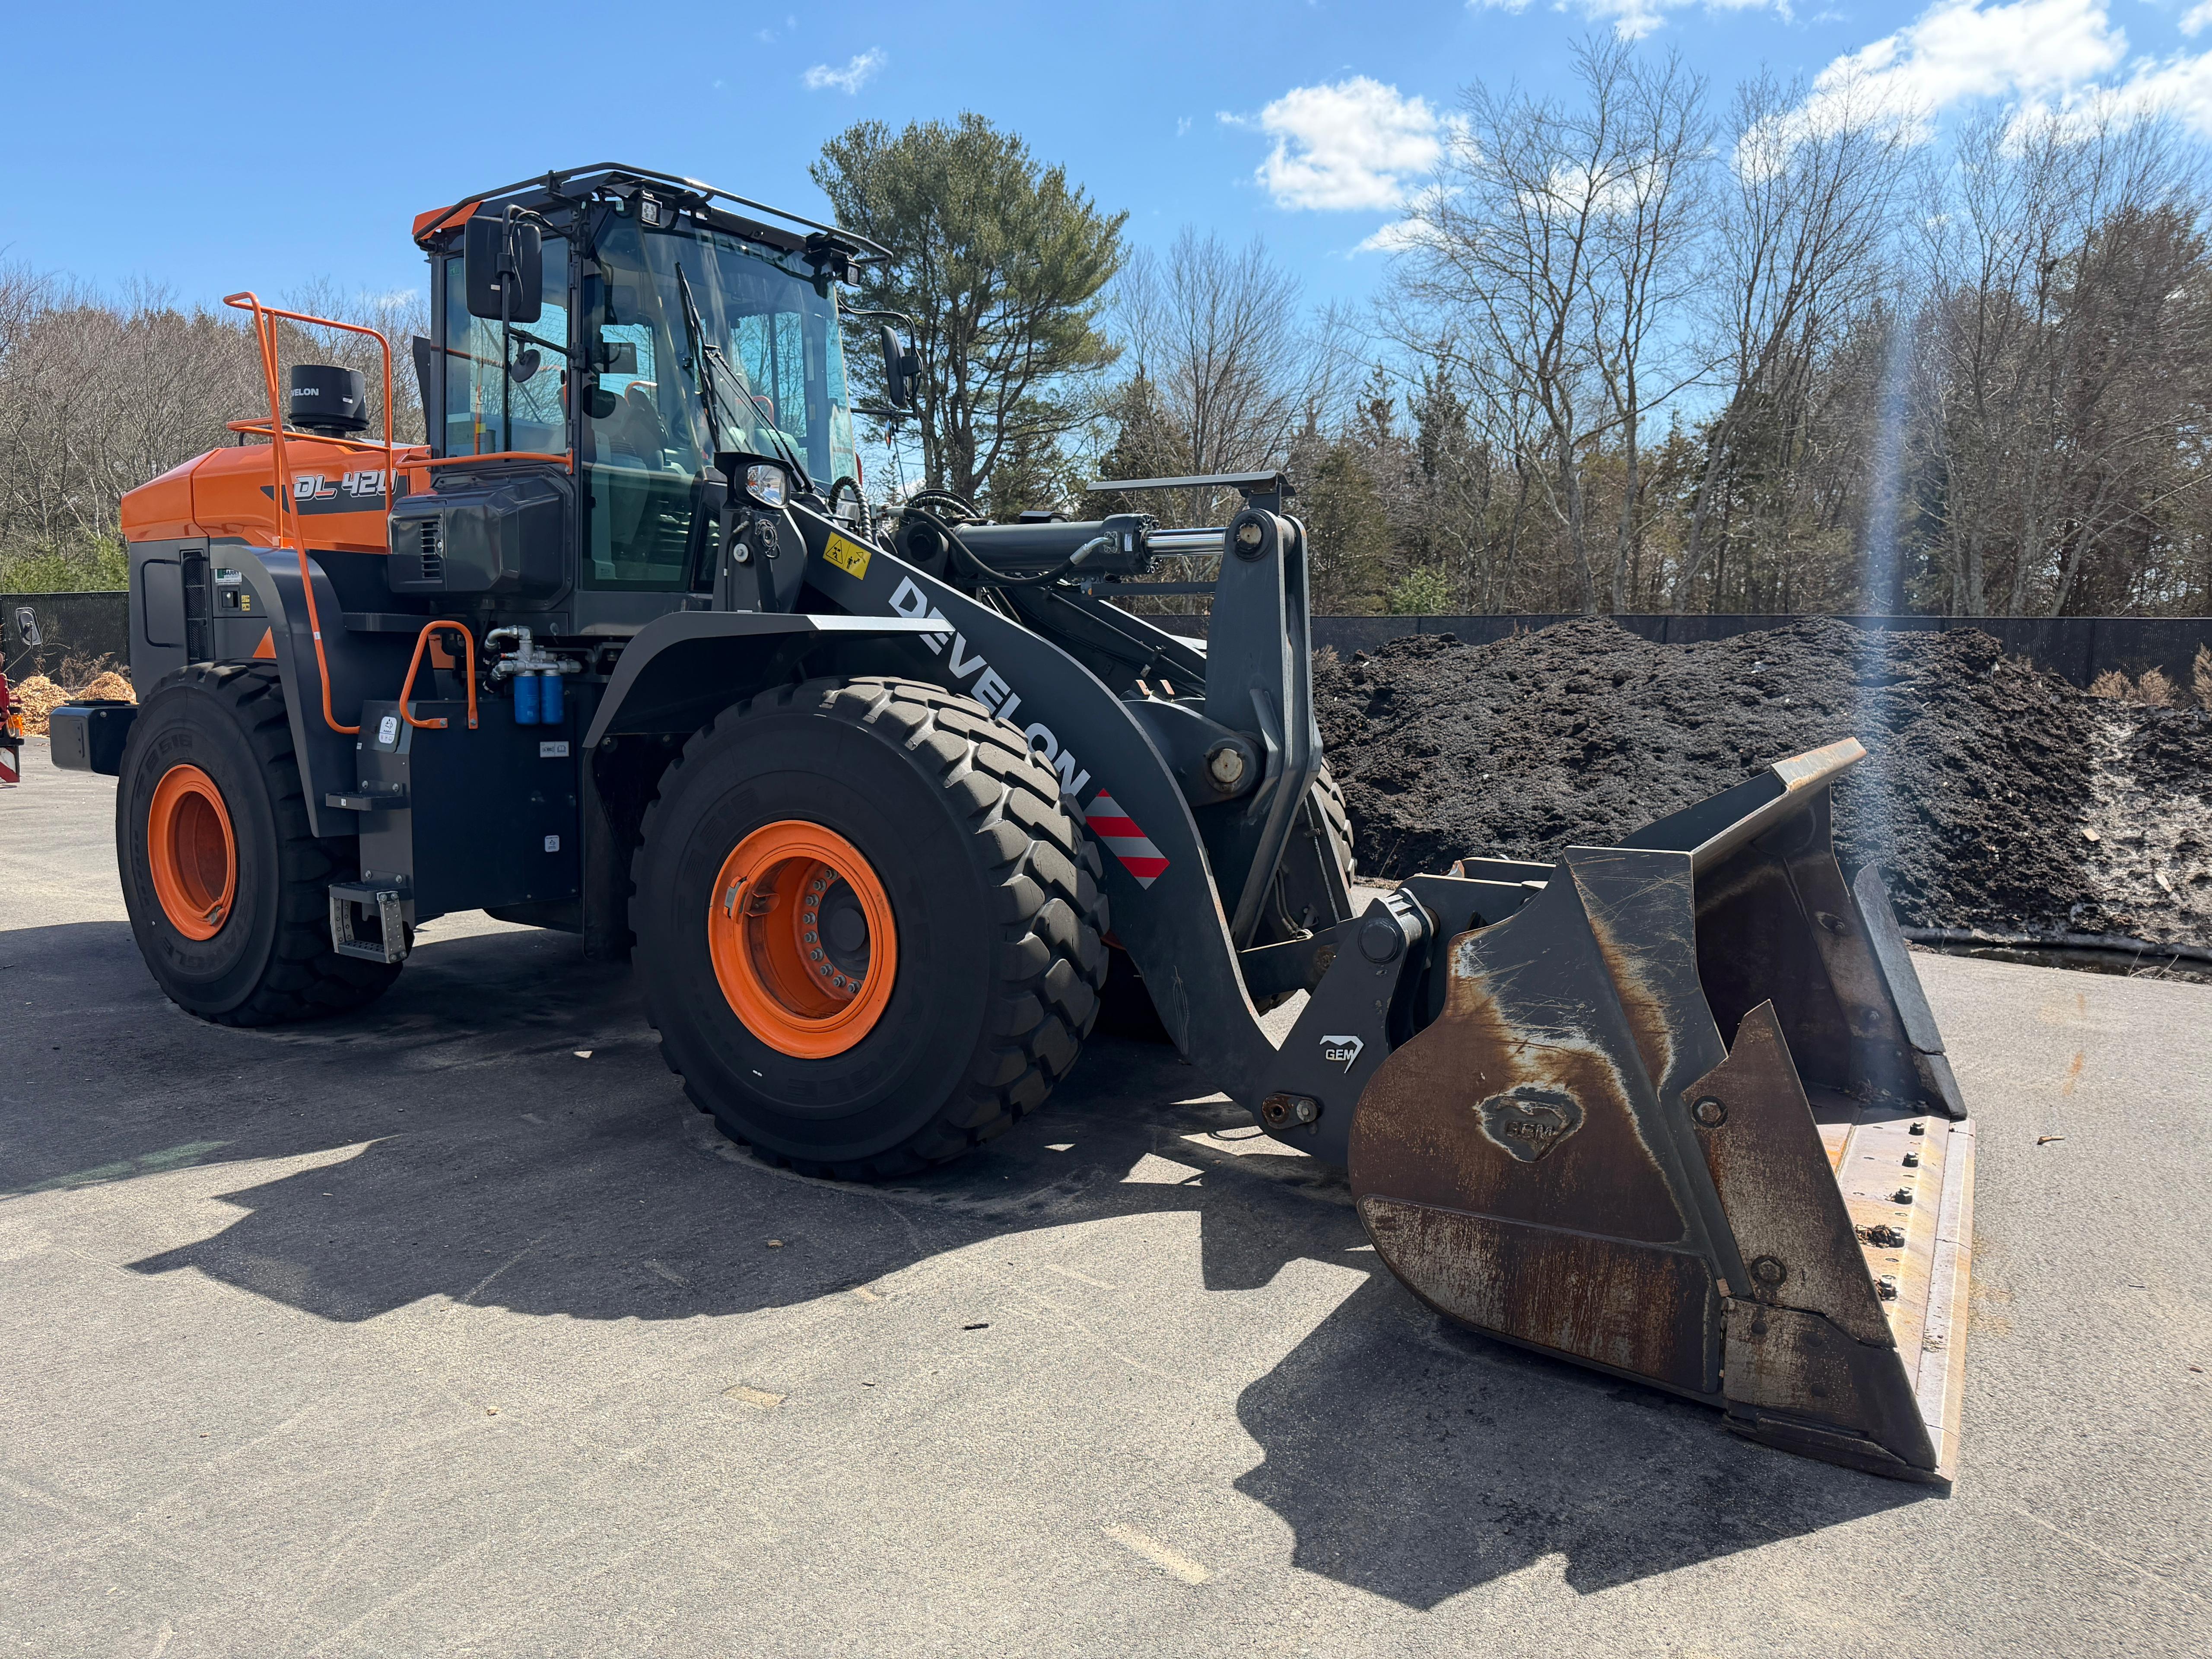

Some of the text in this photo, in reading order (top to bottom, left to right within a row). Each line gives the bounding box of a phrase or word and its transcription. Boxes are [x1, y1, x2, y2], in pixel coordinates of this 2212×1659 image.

[695, 228, 802, 273] DEVELON
[294, 468, 398, 501] DL 420
[1325, 1049, 1354, 1061] GEM
